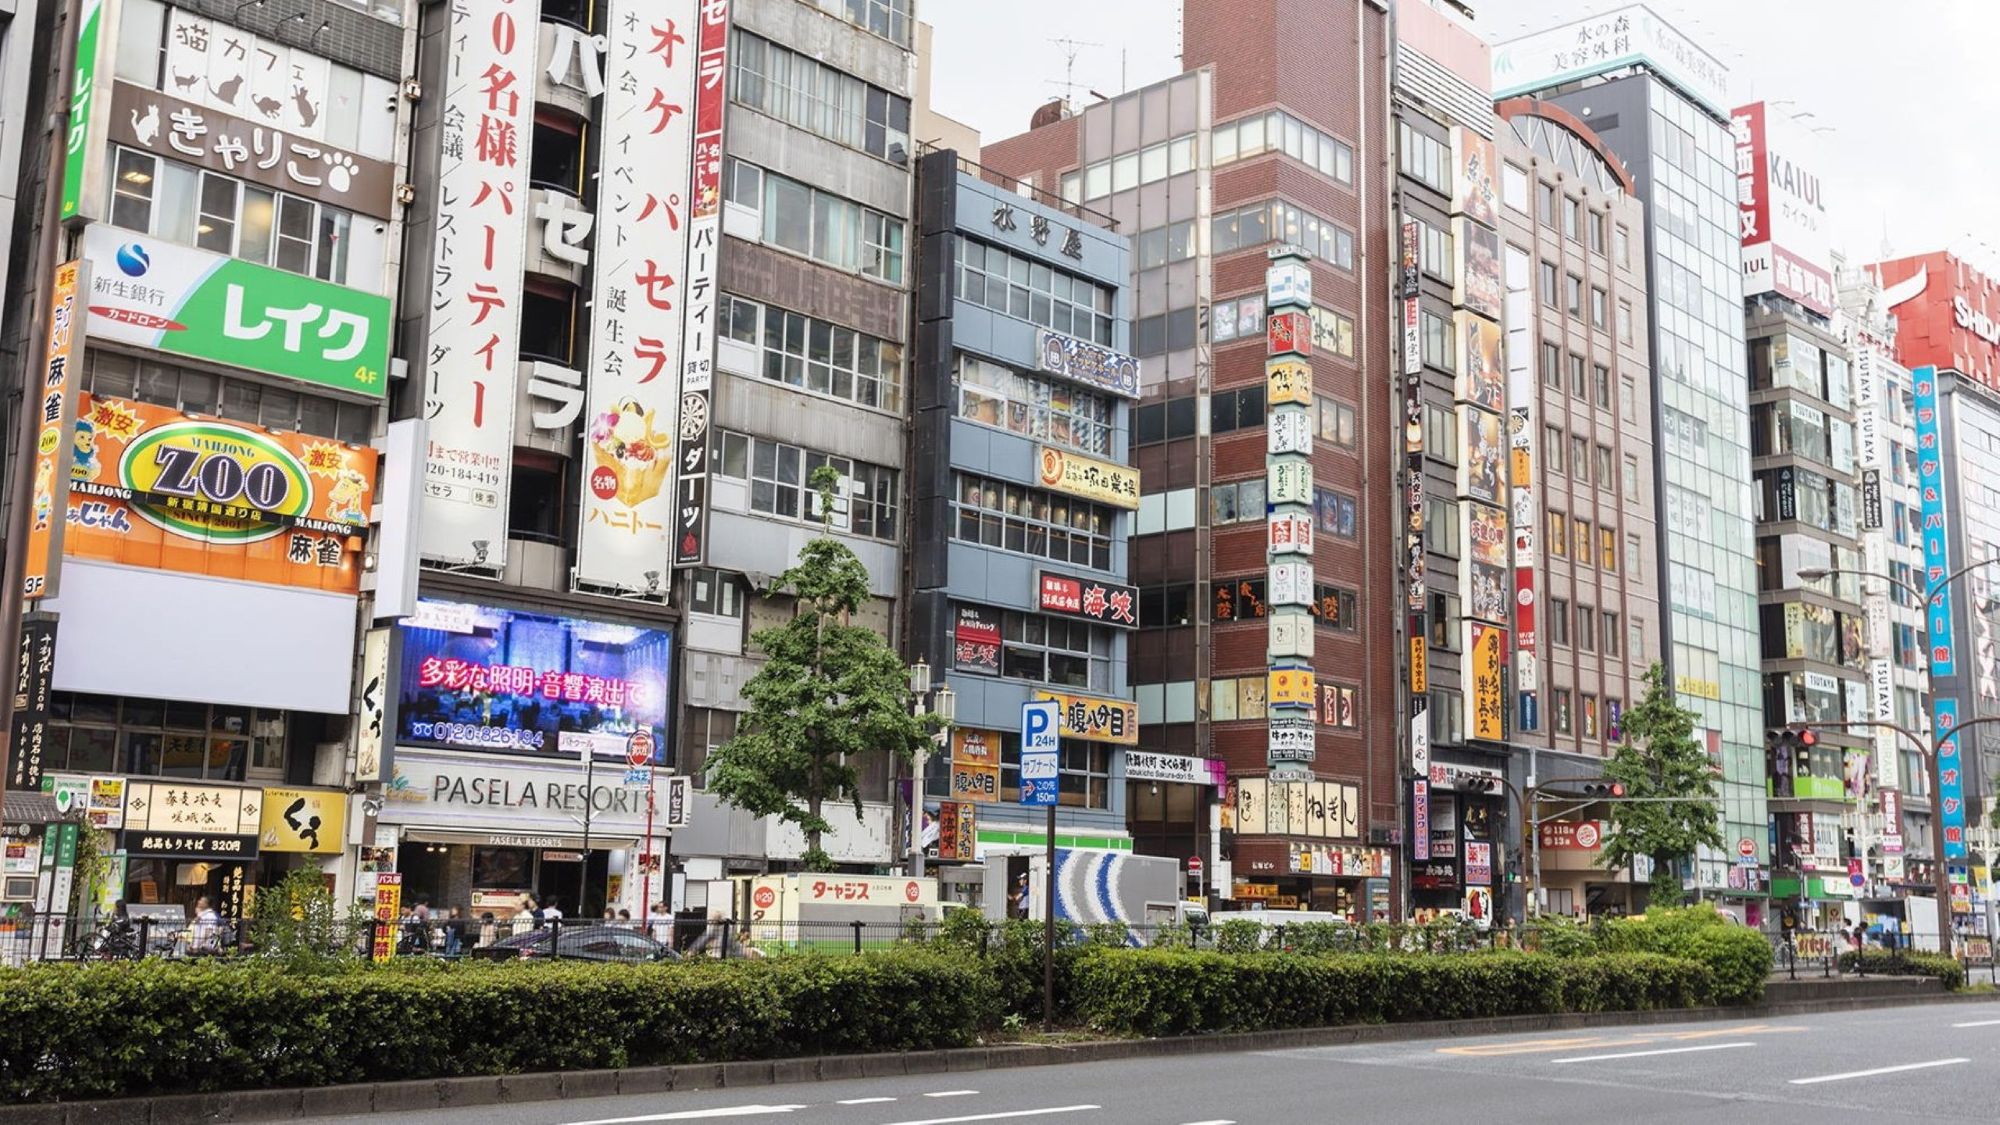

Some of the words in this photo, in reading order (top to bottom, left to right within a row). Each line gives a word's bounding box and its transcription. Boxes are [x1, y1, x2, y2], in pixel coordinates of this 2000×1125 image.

[1577, 15, 1630, 44] 水の森
[176, 22, 305, 82] 猫カフェ
[1554, 35, 1631, 70] 美容外科
[69, 66, 91, 154] レイク
[168, 107, 322, 187] きゃりこ
[1770, 151, 1825, 213] KAIUL
[467, 0, 517, 428] 0名様パーティー
[526, 22, 607, 430] パセラ
[94, 276, 165, 307] 新生銀行
[692, 227, 714, 352] パーティー
[107, 308, 169, 330] カードローン
[223, 284, 370, 362] レイク
[44, 355, 67, 423] 麻雀
[354, 366, 378, 385] 4F
[1859, 350, 1871, 400] TSUTAYA
[94, 406, 134, 435] 激安
[192, 436, 256, 458] MAHJONG
[1863, 411, 1875, 463] TSUTAYA
[309, 450, 343, 470] 激安
[153, 446, 289, 511] ZOO
[593, 475, 617, 490] 名物
[683, 447, 704, 528] ダーツ
[67, 502, 132, 533] あじゃん
[167, 497, 262, 521] 新宿靖国通り店
[589, 507, 663, 535] ハニトー
[295, 517, 352, 536] MAHJONG
[289, 535, 342, 567] 麻雀
[25, 578, 44, 594] 3F
[1809, 675, 1835, 689] TSUTAYA
[1877, 663, 1889, 718] TSUTAYA
[1026, 708, 1049, 748] P
[1052, 701, 1125, 737] 腹八分目
[1035, 735, 1056, 747] 24H
[1272, 730, 1295, 741] 牛かつ
[1022, 757, 1056, 774] サブナード
[1159, 757, 1193, 772] さくら通り
[433, 774, 537, 809] PASELA
[954, 772, 995, 794] 腹八分目
[1036, 791, 1056, 803] 150m
[283, 797, 322, 850] くう
[1306, 796, 1357, 826] ねぎし
[142, 836, 205, 851] 絶品もりそば
[211, 839, 241, 852] 320円
[490, 836, 522, 846] PASELA
[525, 837, 562, 848] RESORTS
[374, 889, 393, 963] 駐停車禁
